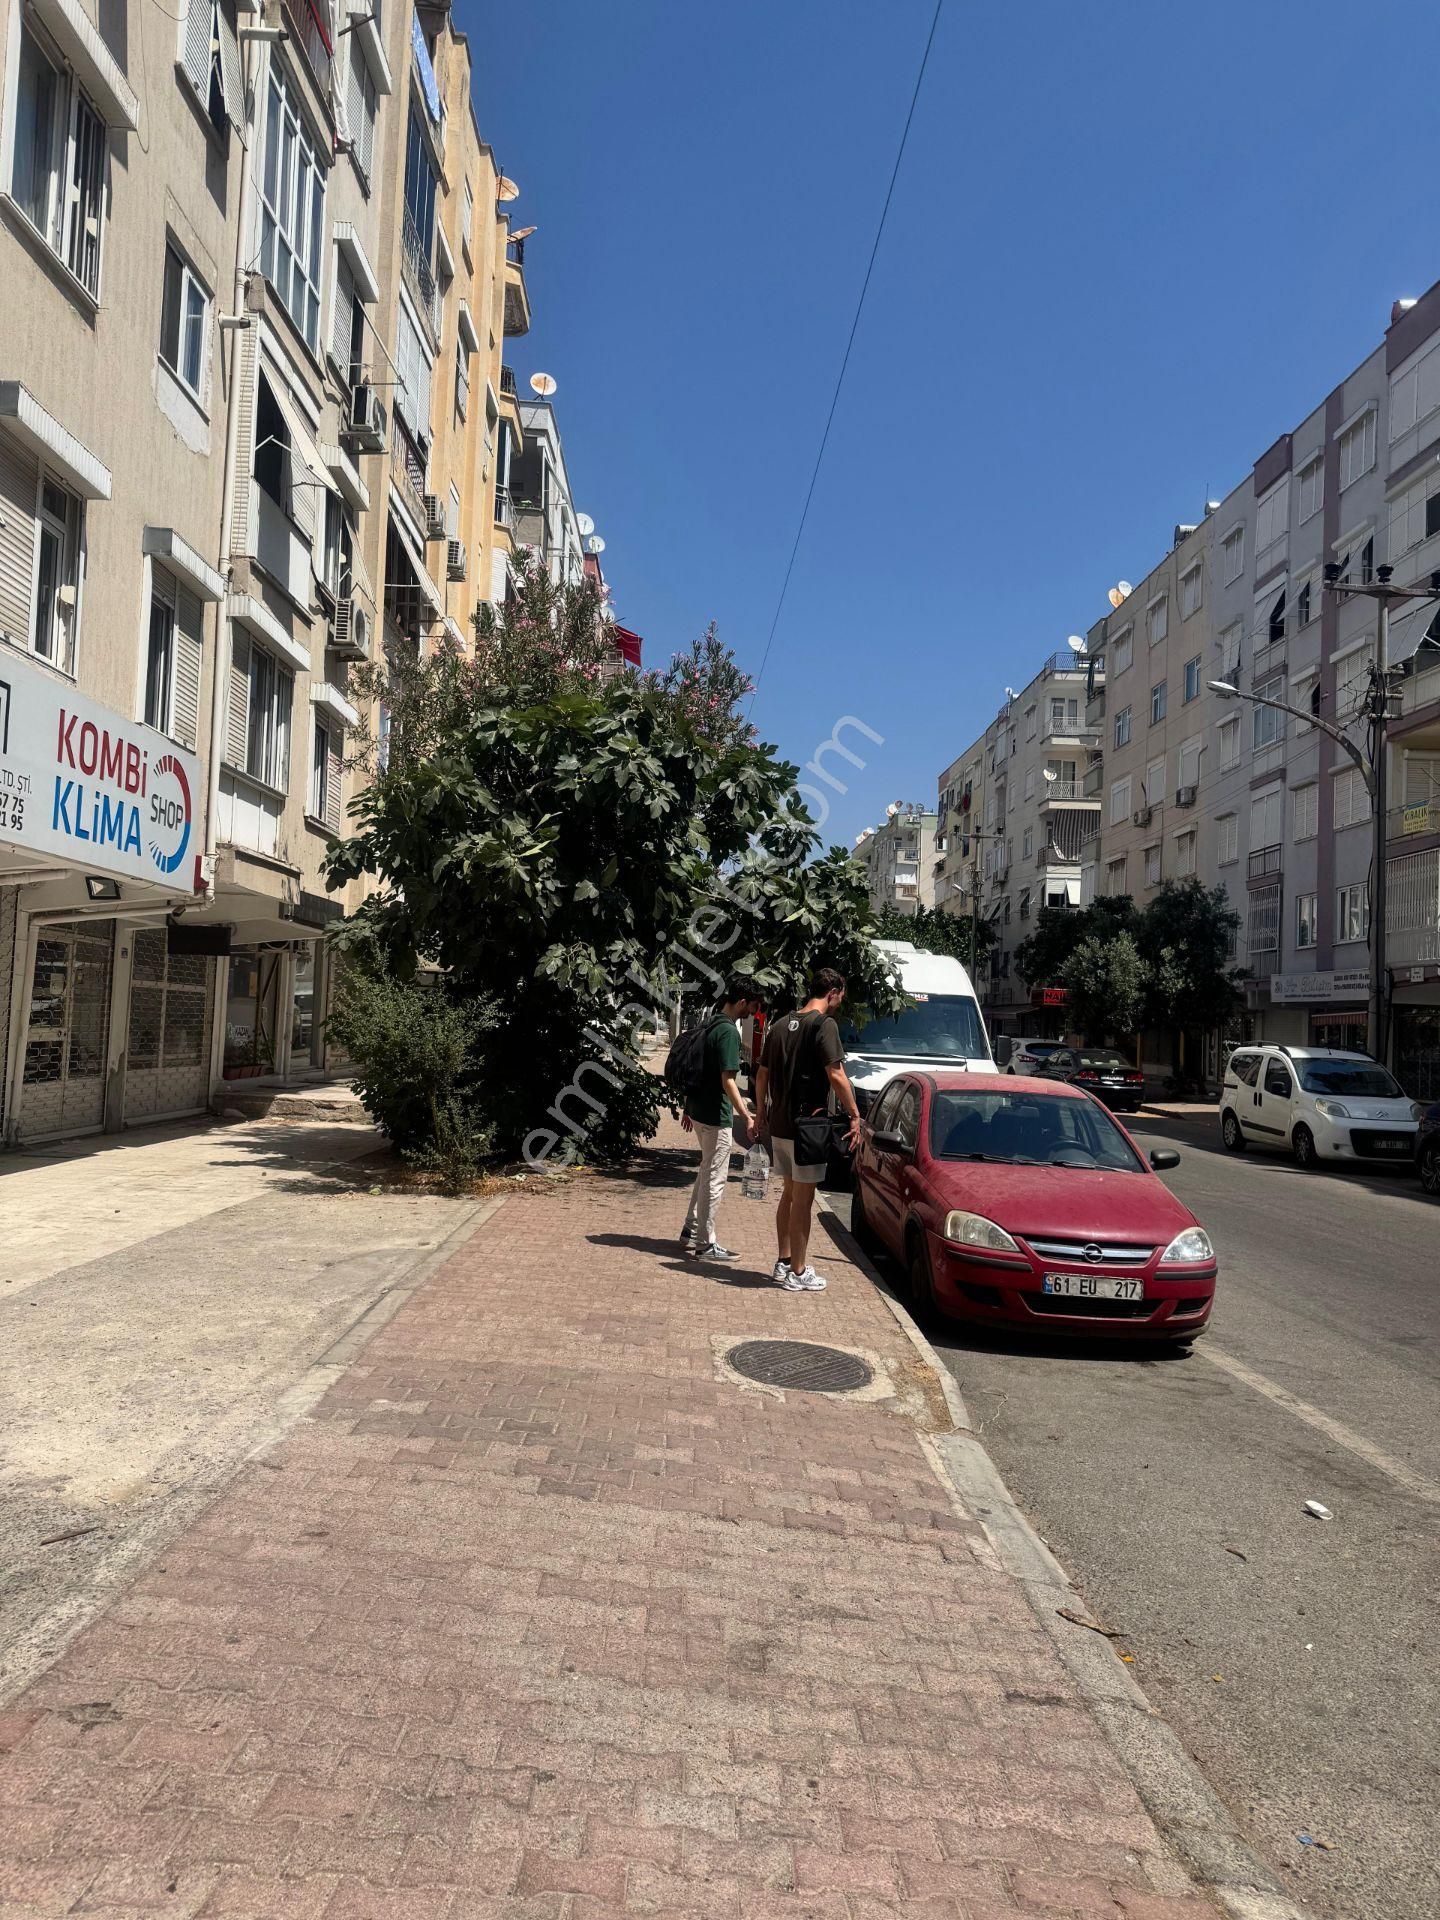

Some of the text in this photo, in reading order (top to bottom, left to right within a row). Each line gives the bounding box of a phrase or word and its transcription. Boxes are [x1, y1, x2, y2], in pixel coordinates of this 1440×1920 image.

[12, 796, 24, 814] 75
[150, 793, 184, 832] SHOP
[11, 814, 23, 831] 95
[1053, 1276, 1070, 1294] 61
[1079, 1278, 1097, 1296] EU
[1114, 1281, 1138, 1299] 217
